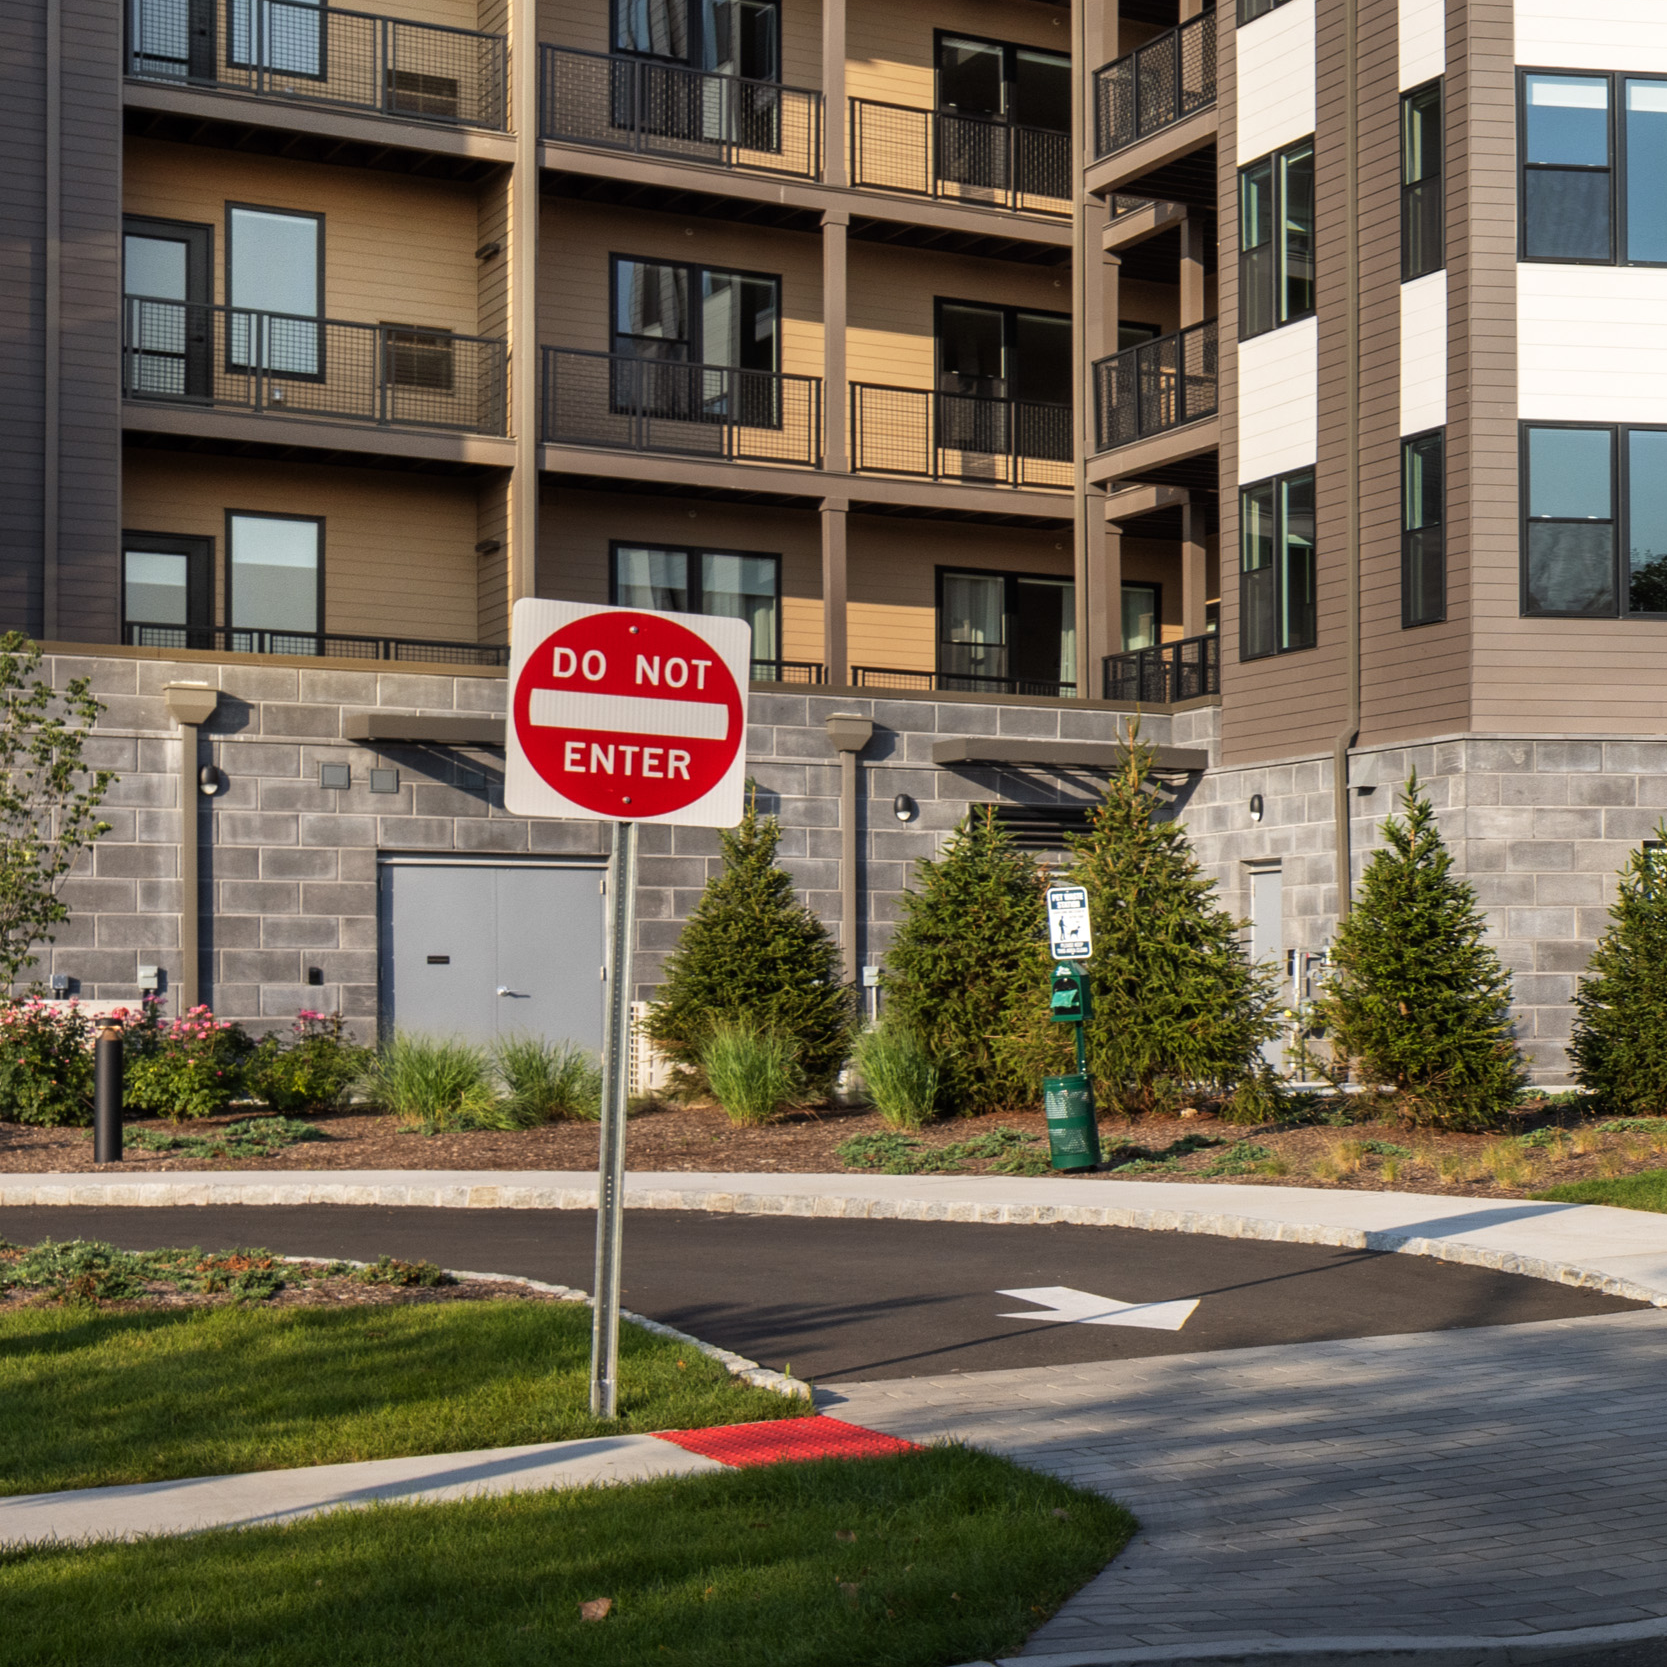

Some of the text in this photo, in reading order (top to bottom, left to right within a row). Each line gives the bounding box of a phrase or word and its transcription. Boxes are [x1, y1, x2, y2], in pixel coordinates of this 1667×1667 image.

[552, 646, 713, 690] DO NOT
[563, 740, 692, 781] ENTER
